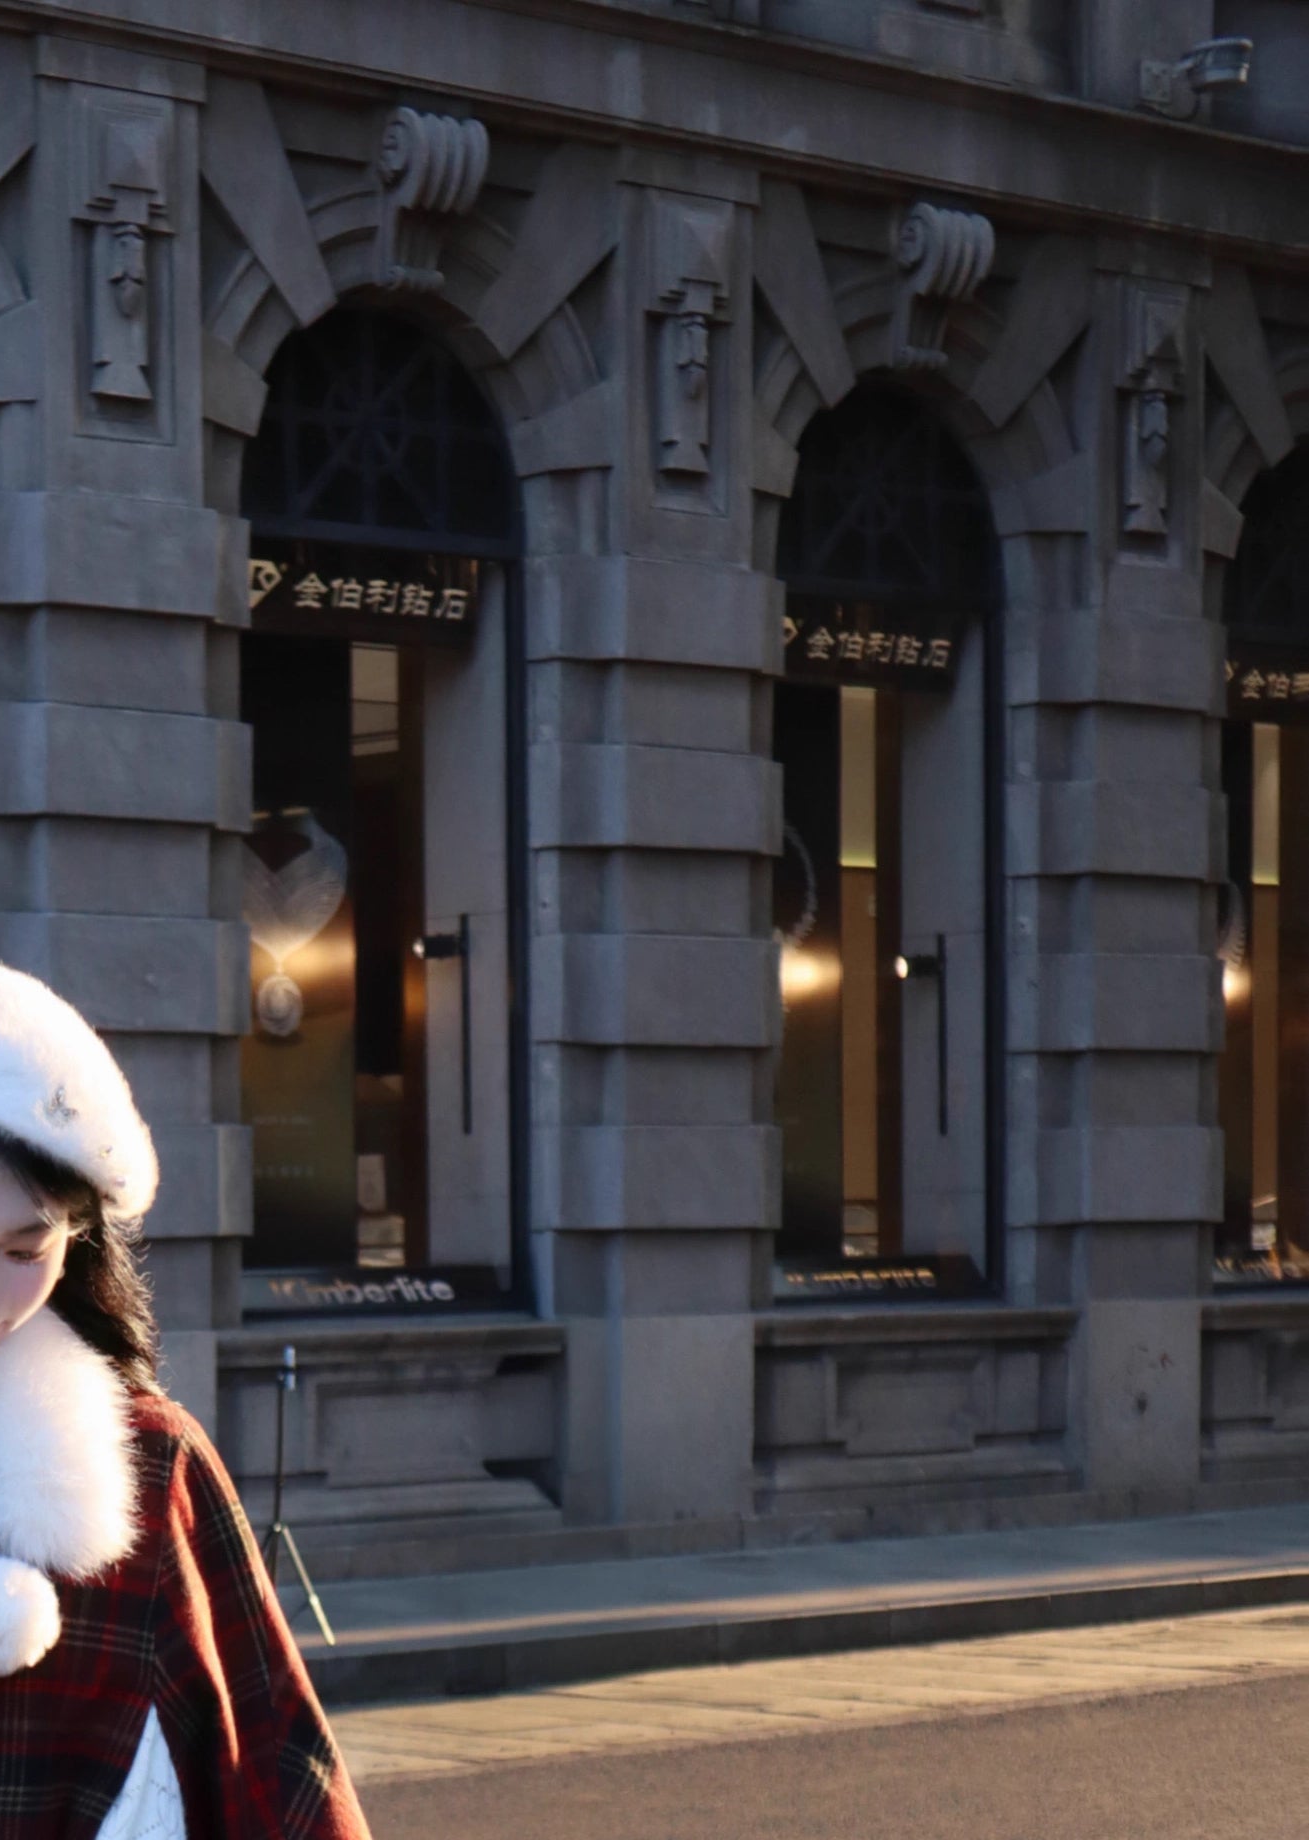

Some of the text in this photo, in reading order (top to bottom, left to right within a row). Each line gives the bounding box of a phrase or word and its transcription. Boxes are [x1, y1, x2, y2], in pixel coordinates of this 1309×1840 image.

[294, 572, 469, 620] 金伯利钻石
